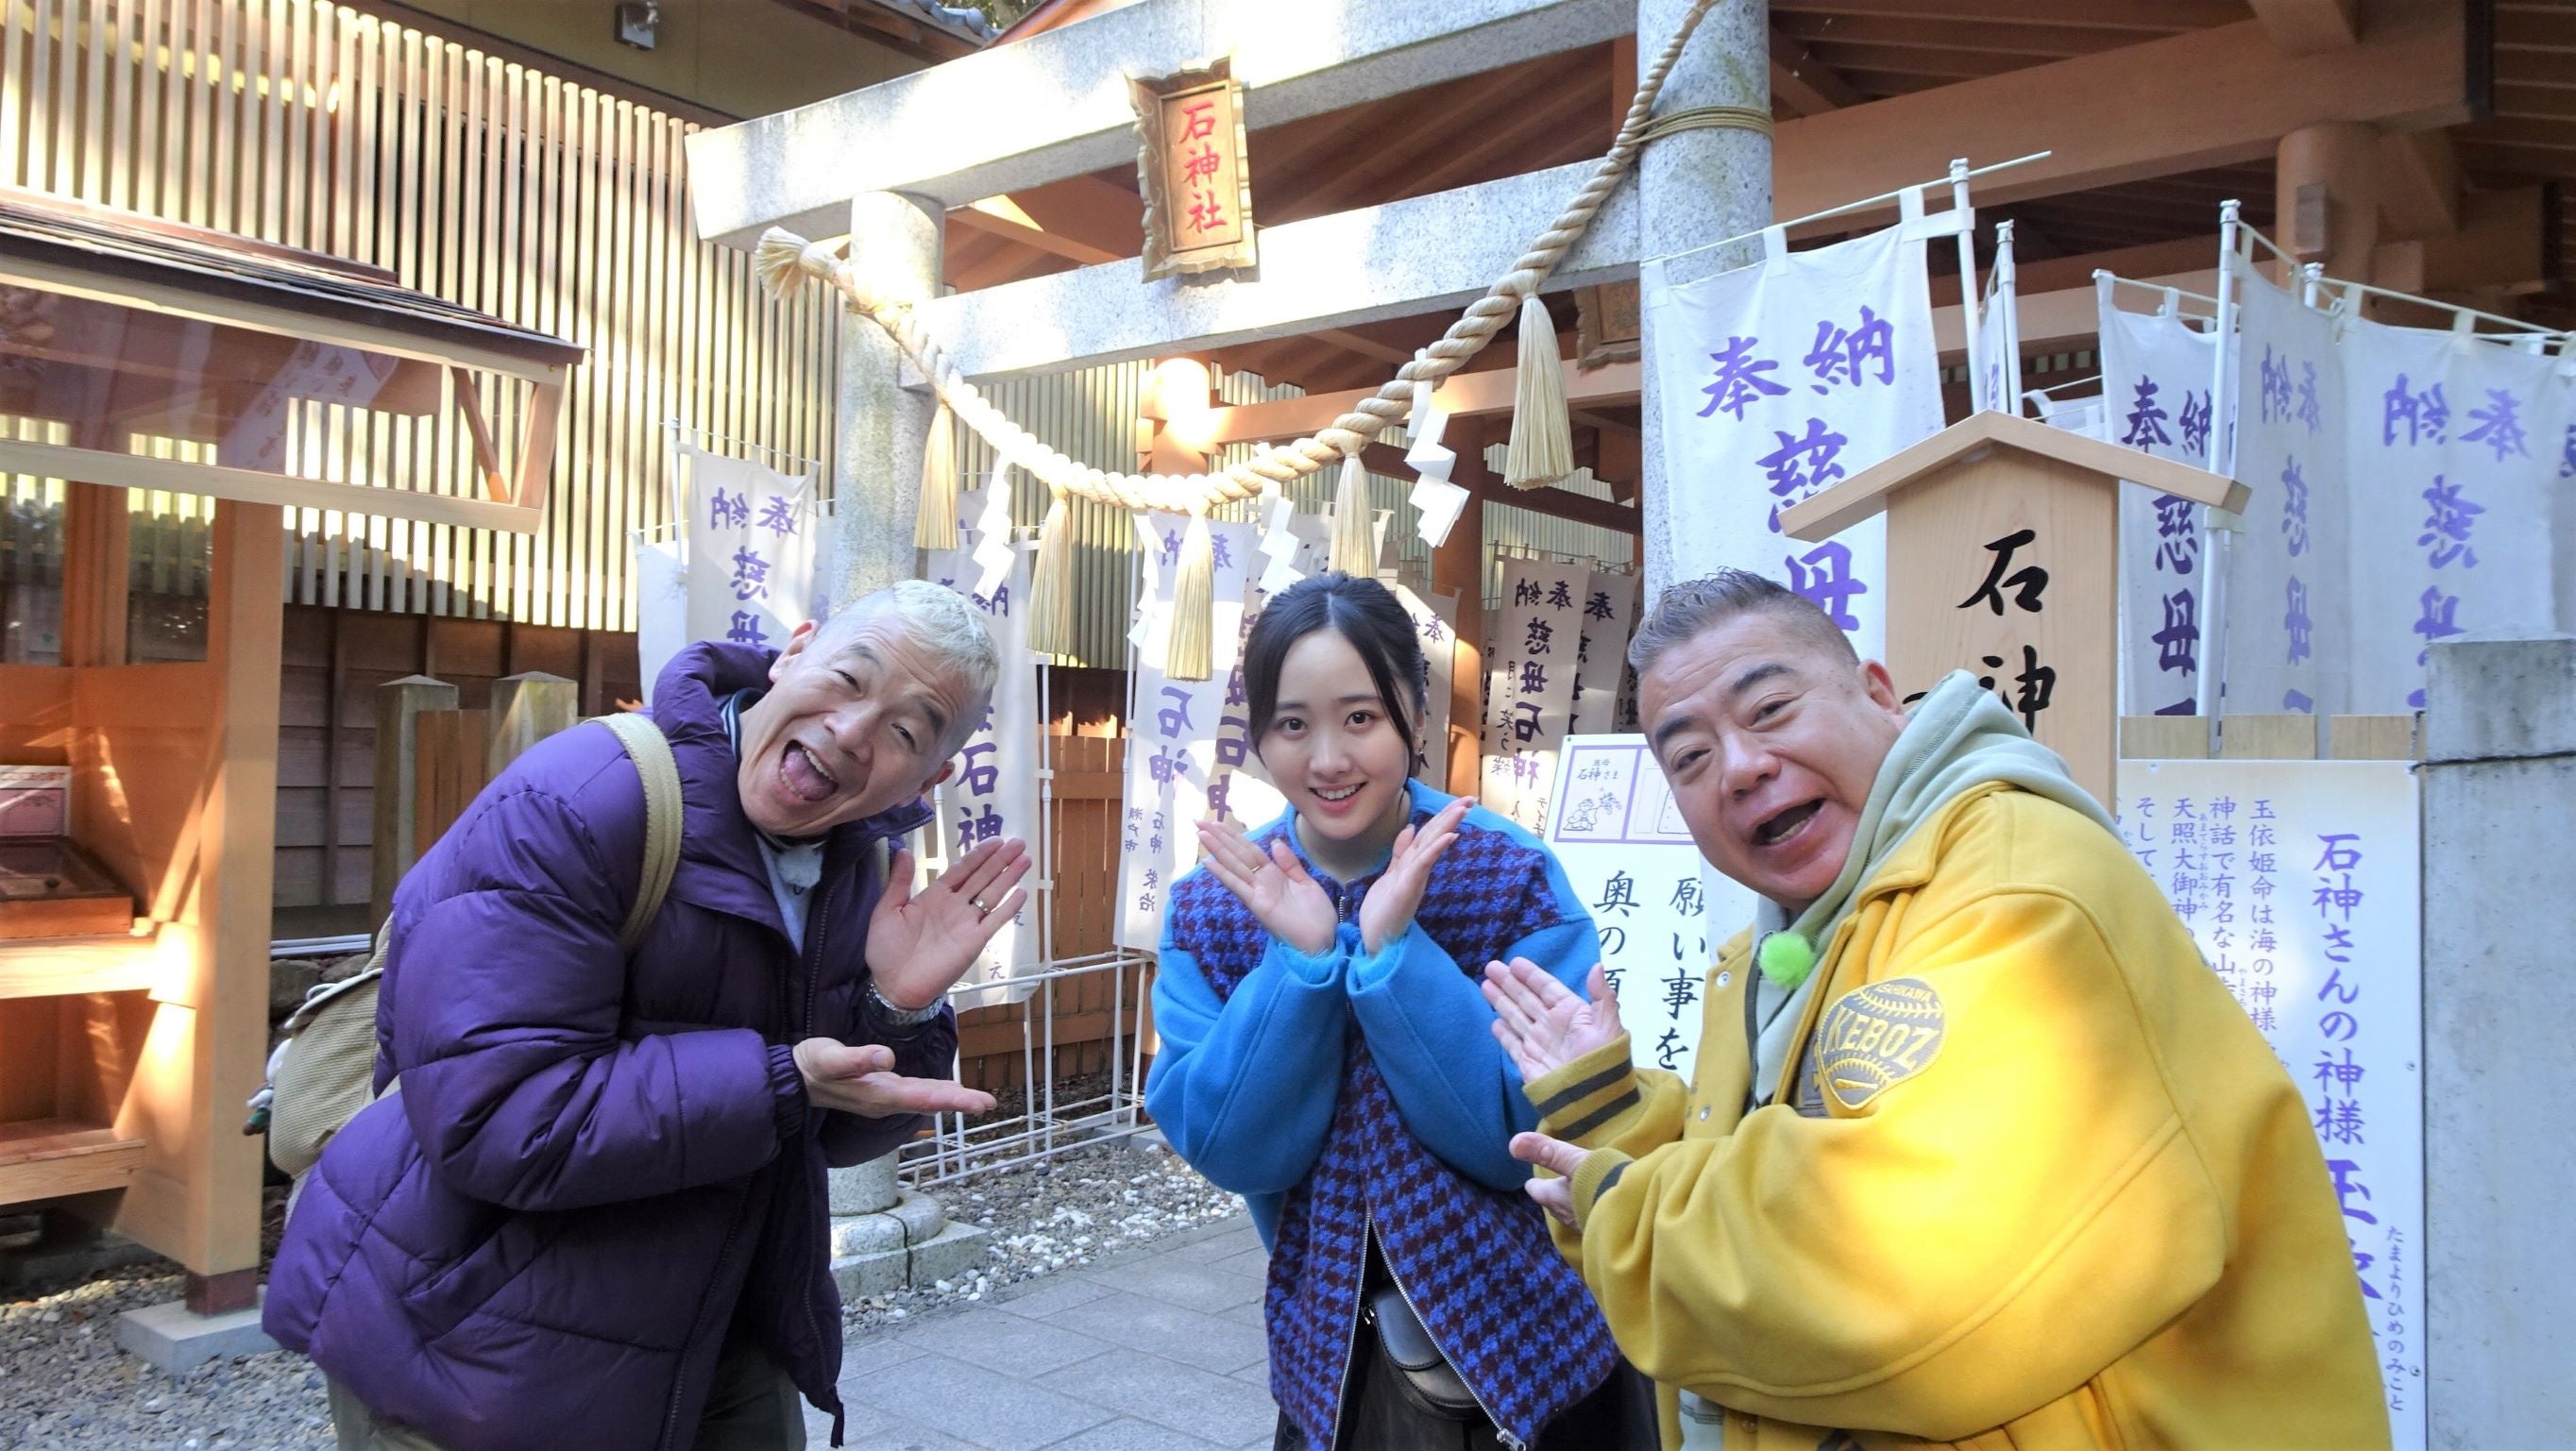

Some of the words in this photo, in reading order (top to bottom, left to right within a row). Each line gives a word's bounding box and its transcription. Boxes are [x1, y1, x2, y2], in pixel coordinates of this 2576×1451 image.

[1180, 100, 1228, 234] 石神社
[1696, 304, 1895, 422] 奉納
[2122, 375, 2212, 458] 奉納
[1755, 416, 1868, 632] 慈母
[2152, 495, 2200, 716] 慈母
[1956, 529, 2057, 734] 石神
[1654, 877, 1707, 1071] 願い事を
[2247, 799, 2279, 1052] 玉依姫命は海の神様
[2312, 833, 2366, 1145] 石神さんの神様
[1822, 1004, 1940, 1071] KEBOZ
